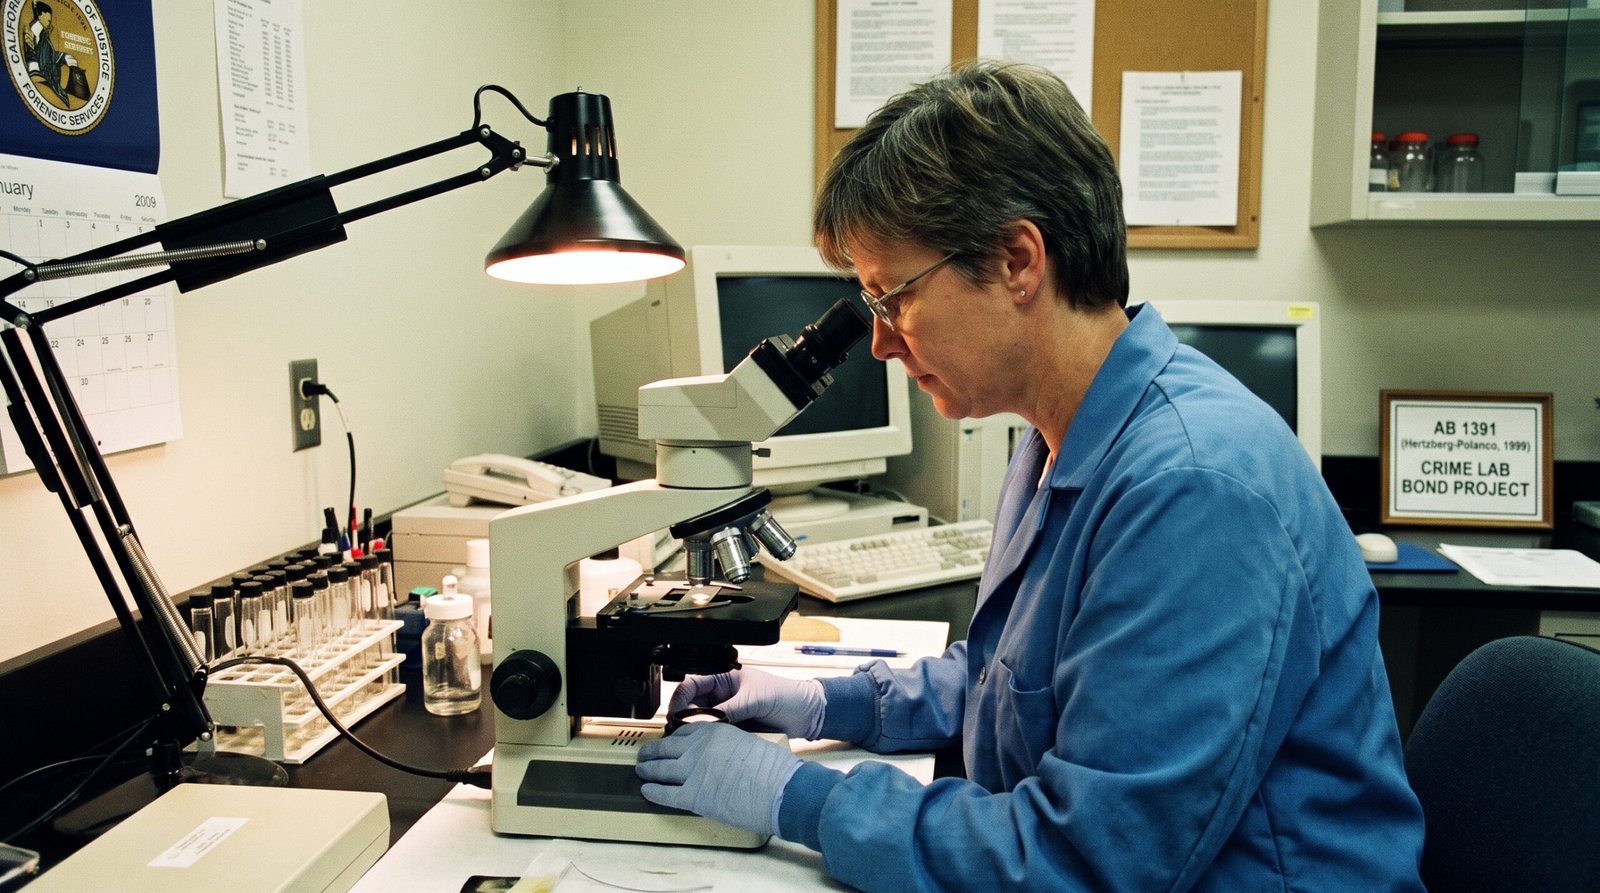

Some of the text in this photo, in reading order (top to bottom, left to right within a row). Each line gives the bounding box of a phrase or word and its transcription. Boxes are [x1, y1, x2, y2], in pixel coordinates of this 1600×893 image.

[85, 5, 97, 20] OF
[94, 26, 110, 80] JUSTICE
[23, 82, 104, 126] FORENSIC SERVICES
[135, 194, 156, 208] 2009
[17, 300, 26, 309] 14
[46, 300, 55, 308] 15
[51, 340, 59, 348] 22
[77, 339, 85, 347] 24
[102, 337, 109, 345] 25
[147, 333, 154, 341] 27
[80, 378, 89, 386] 30
[1434, 421, 1497, 436] AB 1391
[1401, 439, 1531, 453] (Hertzberg-Polanco, 1999)
[1421, 461, 1510, 477] CRIME LAB
[1402, 480, 1530, 497] BOND PROJECT
